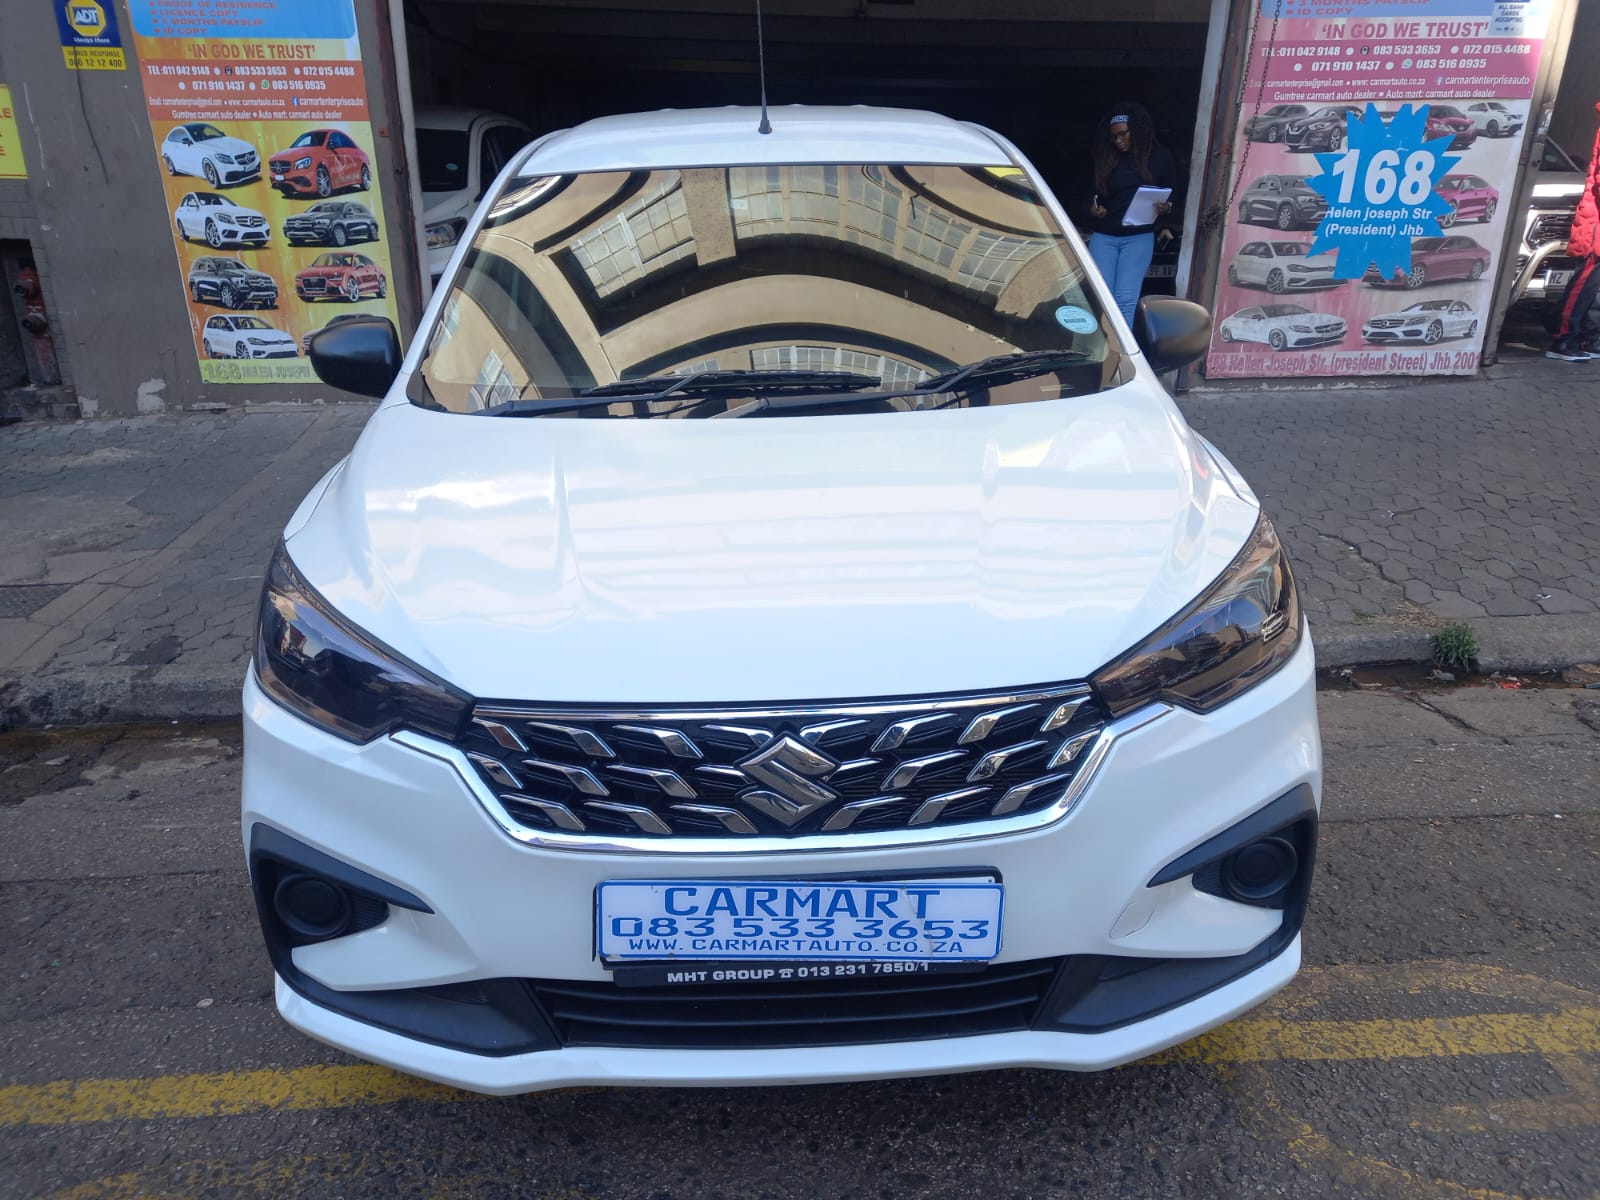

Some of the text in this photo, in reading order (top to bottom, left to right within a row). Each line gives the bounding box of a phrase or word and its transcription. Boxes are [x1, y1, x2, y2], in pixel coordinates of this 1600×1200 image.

[75, 9, 98, 24] ADT
[1350, 23, 1388, 38] GOD
[1393, 22, 1420, 37] WE
[211, 44, 240, 58] GOD
[243, 44, 264, 58] WE
[1296, 47, 1316, 56] 042
[1317, 46, 1340, 56] 9148
[1373, 46, 1392, 54] 083
[1394, 46, 1414, 54] 533
[1414, 45, 1440, 54] 3653
[1462, 45, 1481, 54] 072
[1484, 44, 1502, 54] 015
[1504, 44, 1531, 54] 4488
[1312, 59, 1487, 71] 071 910 1437 083 516 0935
[192, 80, 207, 90] 071
[226, 81, 245, 90] 1437
[1445, 75, 1530, 86] carmartenterpriseauto
[1336, 91, 1352, 100] auto
[1354, 90, 1376, 100] dealer
[1386, 90, 1404, 98] Auto
[1425, 90, 1453, 98] carmart
[1454, 89, 1470, 98] auto
[1472, 88, 1496, 98] dealer
[1332, 148, 1436, 206] 168
[1324, 206, 1362, 219] Helen
[1363, 206, 1410, 221] joseph
[1325, 224, 1424, 238] (President) Jhb
[1331, 352, 1388, 373] (president
[1389, 352, 1428, 371] Street)
[1430, 352, 1451, 370] Jhb
[664, 887, 940, 919] CARMART
[612, 917, 990, 940] 083 533 3653
[667, 962, 928, 983] MHT GROUP 013 231 7850/1
